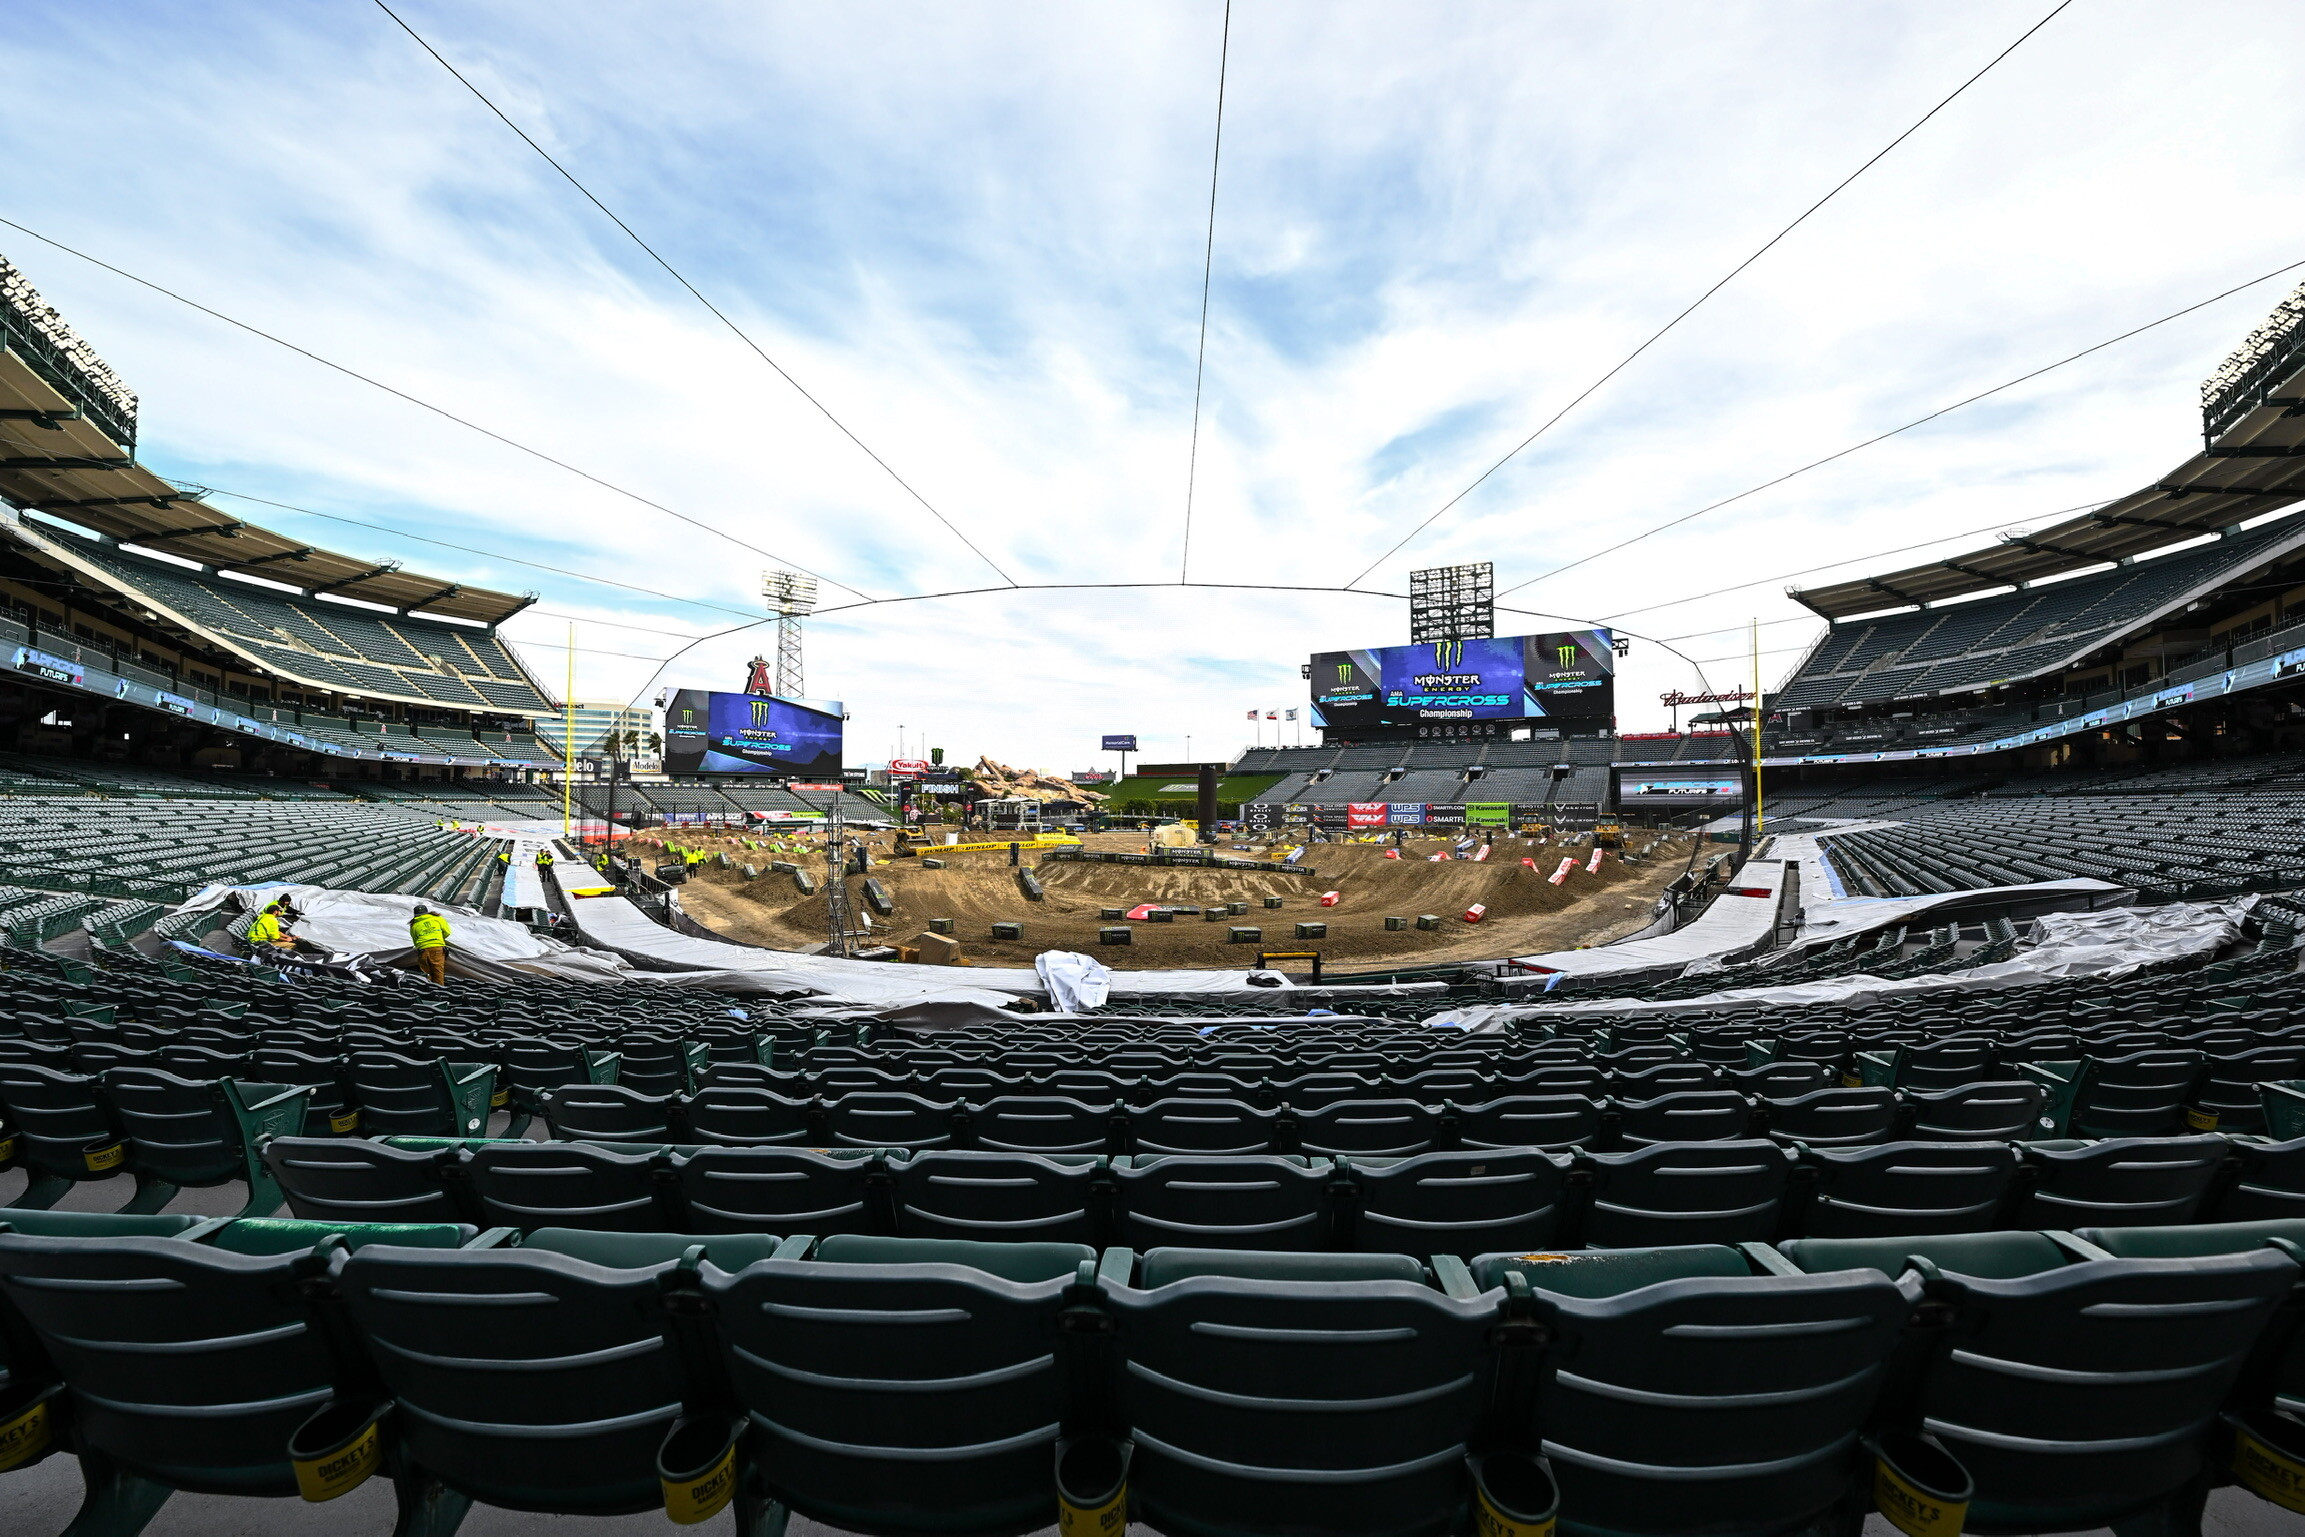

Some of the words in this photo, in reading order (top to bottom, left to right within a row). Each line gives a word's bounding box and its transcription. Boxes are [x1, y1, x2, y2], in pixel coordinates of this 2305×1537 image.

[40, 667, 68, 681] FUTURES
[1414, 674, 1480, 686] MONSTER
[1534, 680, 1602, 690] SUPERCROSS
[1386, 695, 1510, 706] SUPERCROSS
[1660, 690, 1757, 707] Budweiser
[1420, 709, 1473, 718] Championship
[739, 728, 777, 738] MONSTER
[722, 739, 792, 751] SUPERCROSS
[633, 761, 659, 770] Modelo
[921, 784, 959, 793] FINISH
[1391, 803, 1420, 812] WPS
[1390, 814, 1420, 824] WPS
[1229, 860, 1255, 868] MONSTER
[1281, 865, 1305, 873] MONSTER
[92, 1149, 120, 1161] DICKEY'S
[318, 1436, 374, 1477] DICKEY'S
[692, 1454, 735, 1499] DICKEY'S
[1882, 1473, 1940, 1520] DICKEY'S
